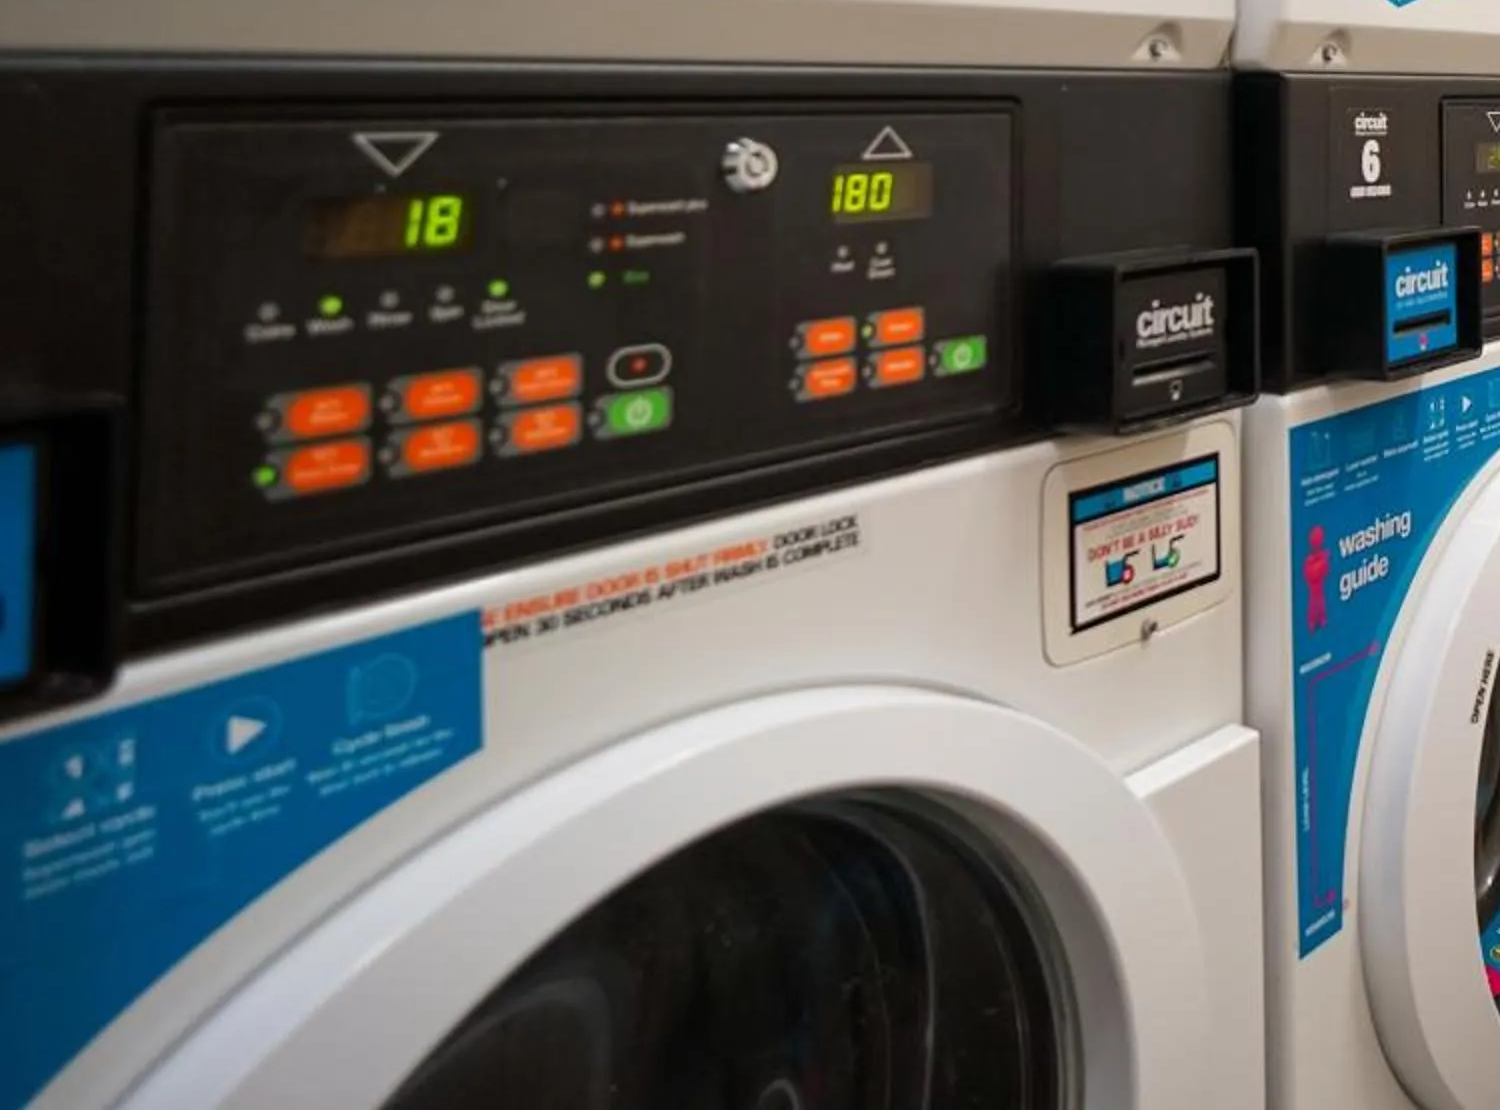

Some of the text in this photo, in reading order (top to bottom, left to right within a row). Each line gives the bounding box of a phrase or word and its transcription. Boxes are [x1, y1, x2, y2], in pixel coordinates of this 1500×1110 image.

[1354, 111, 1388, 131] circuit
[1361, 139, 1381, 184] 6
[832, 171, 893, 214] 180
[405, 194, 463, 248] 18
[1395, 260, 1449, 299] circuit
[1136, 292, 1214, 337] circuit
[1339, 510, 1412, 558] washing
[505, 588, 580, 623] ENSURE
[586, 573, 639, 601] DOOR
[645, 566, 659, 585] IS
[665, 553, 708, 580] SHUT
[774, 524, 817, 549] DOOR
[822, 514, 859, 536] LOCK
[563, 587, 652, 626] SECONDS
[657, 571, 709, 601] AFTER
[714, 559, 763, 585] WASH
[767, 555, 779, 570] IS
[783, 532, 859, 566] COMPLETE
[1339, 554, 1390, 601] guide
